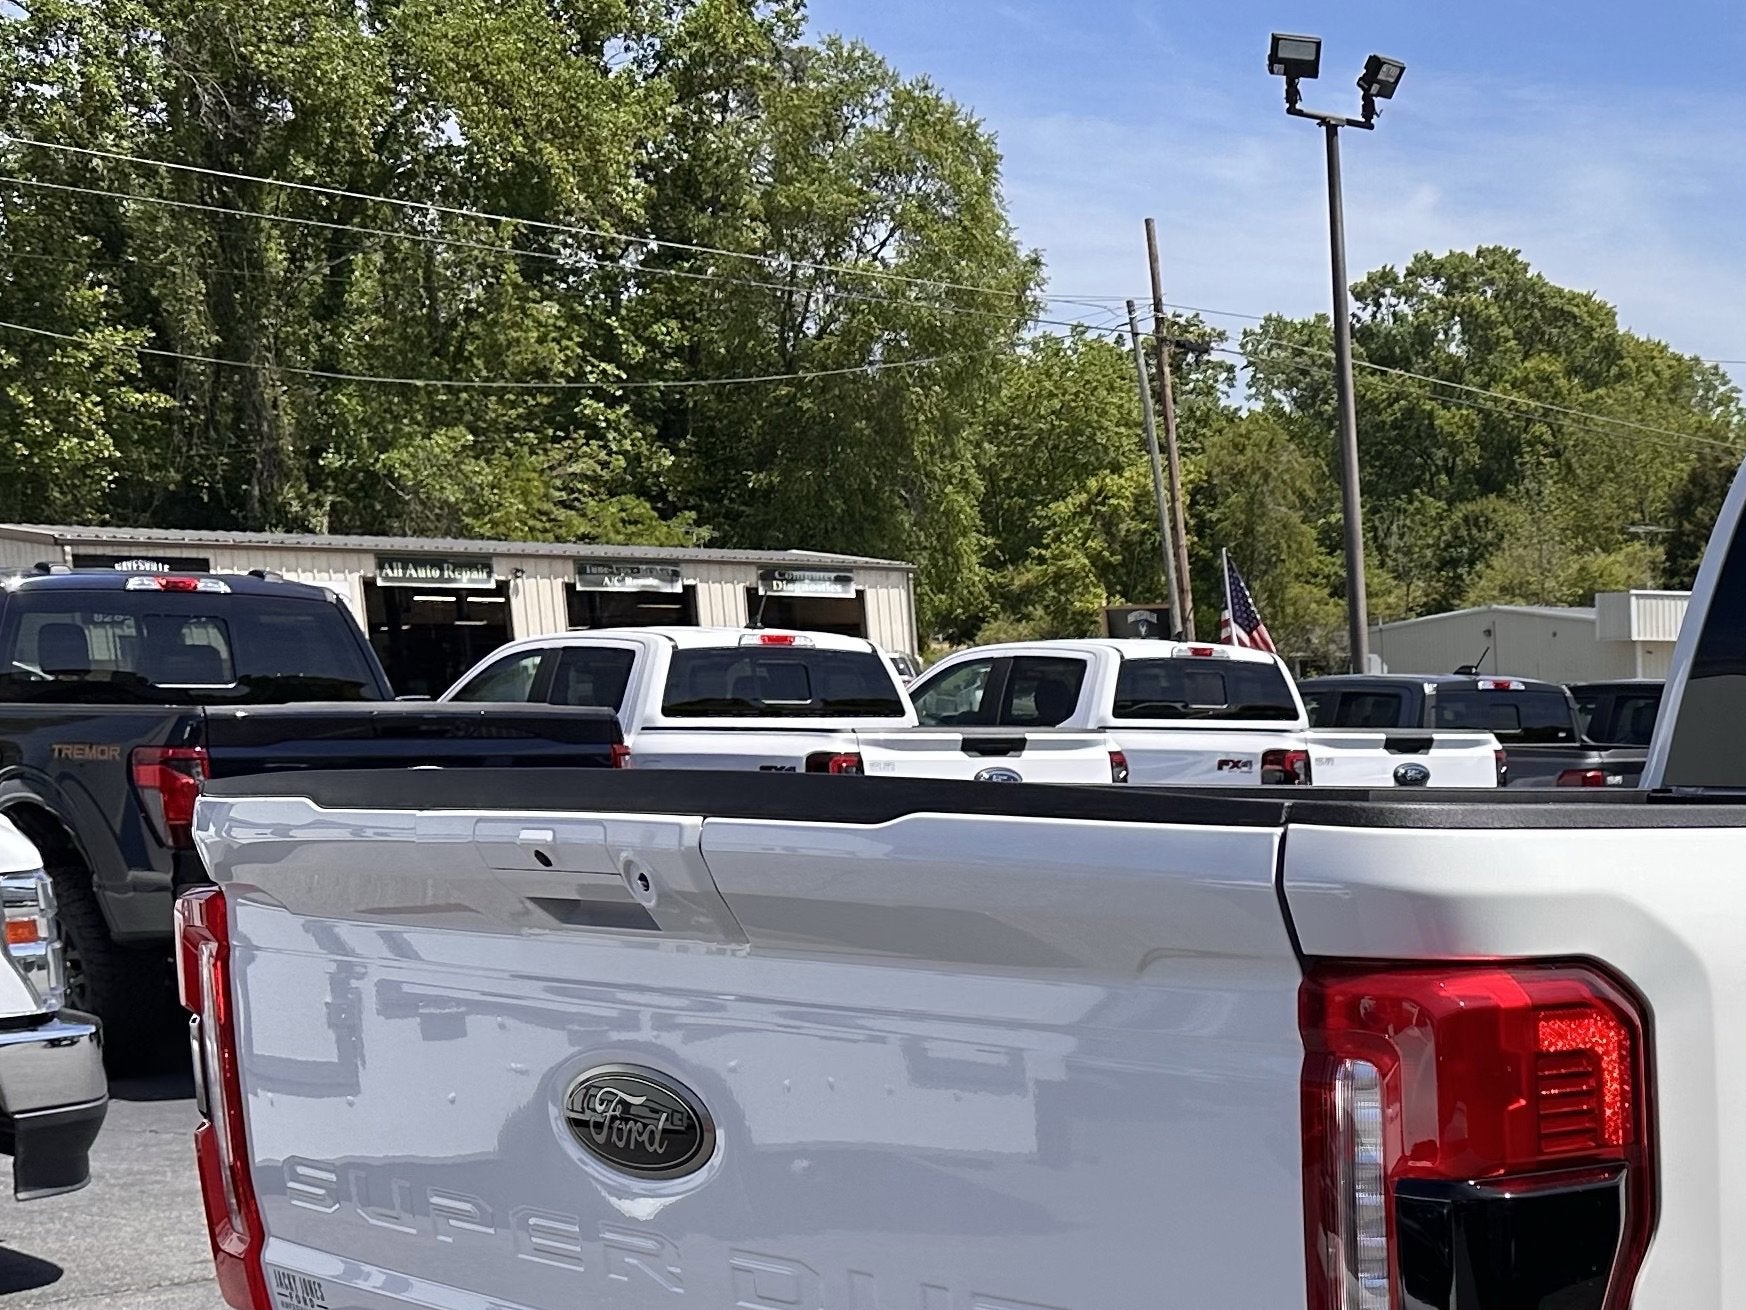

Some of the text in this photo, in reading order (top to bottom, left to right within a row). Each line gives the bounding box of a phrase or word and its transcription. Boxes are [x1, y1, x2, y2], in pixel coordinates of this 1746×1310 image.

[382, 562, 489, 583] All Auto Repair
[52, 744, 121, 761] TREMOR
[589, 1087, 668, 1154] Ford
[284, 1153, 684, 1295] SUPER
[273, 1269, 325, 1301] JACKY JONES
